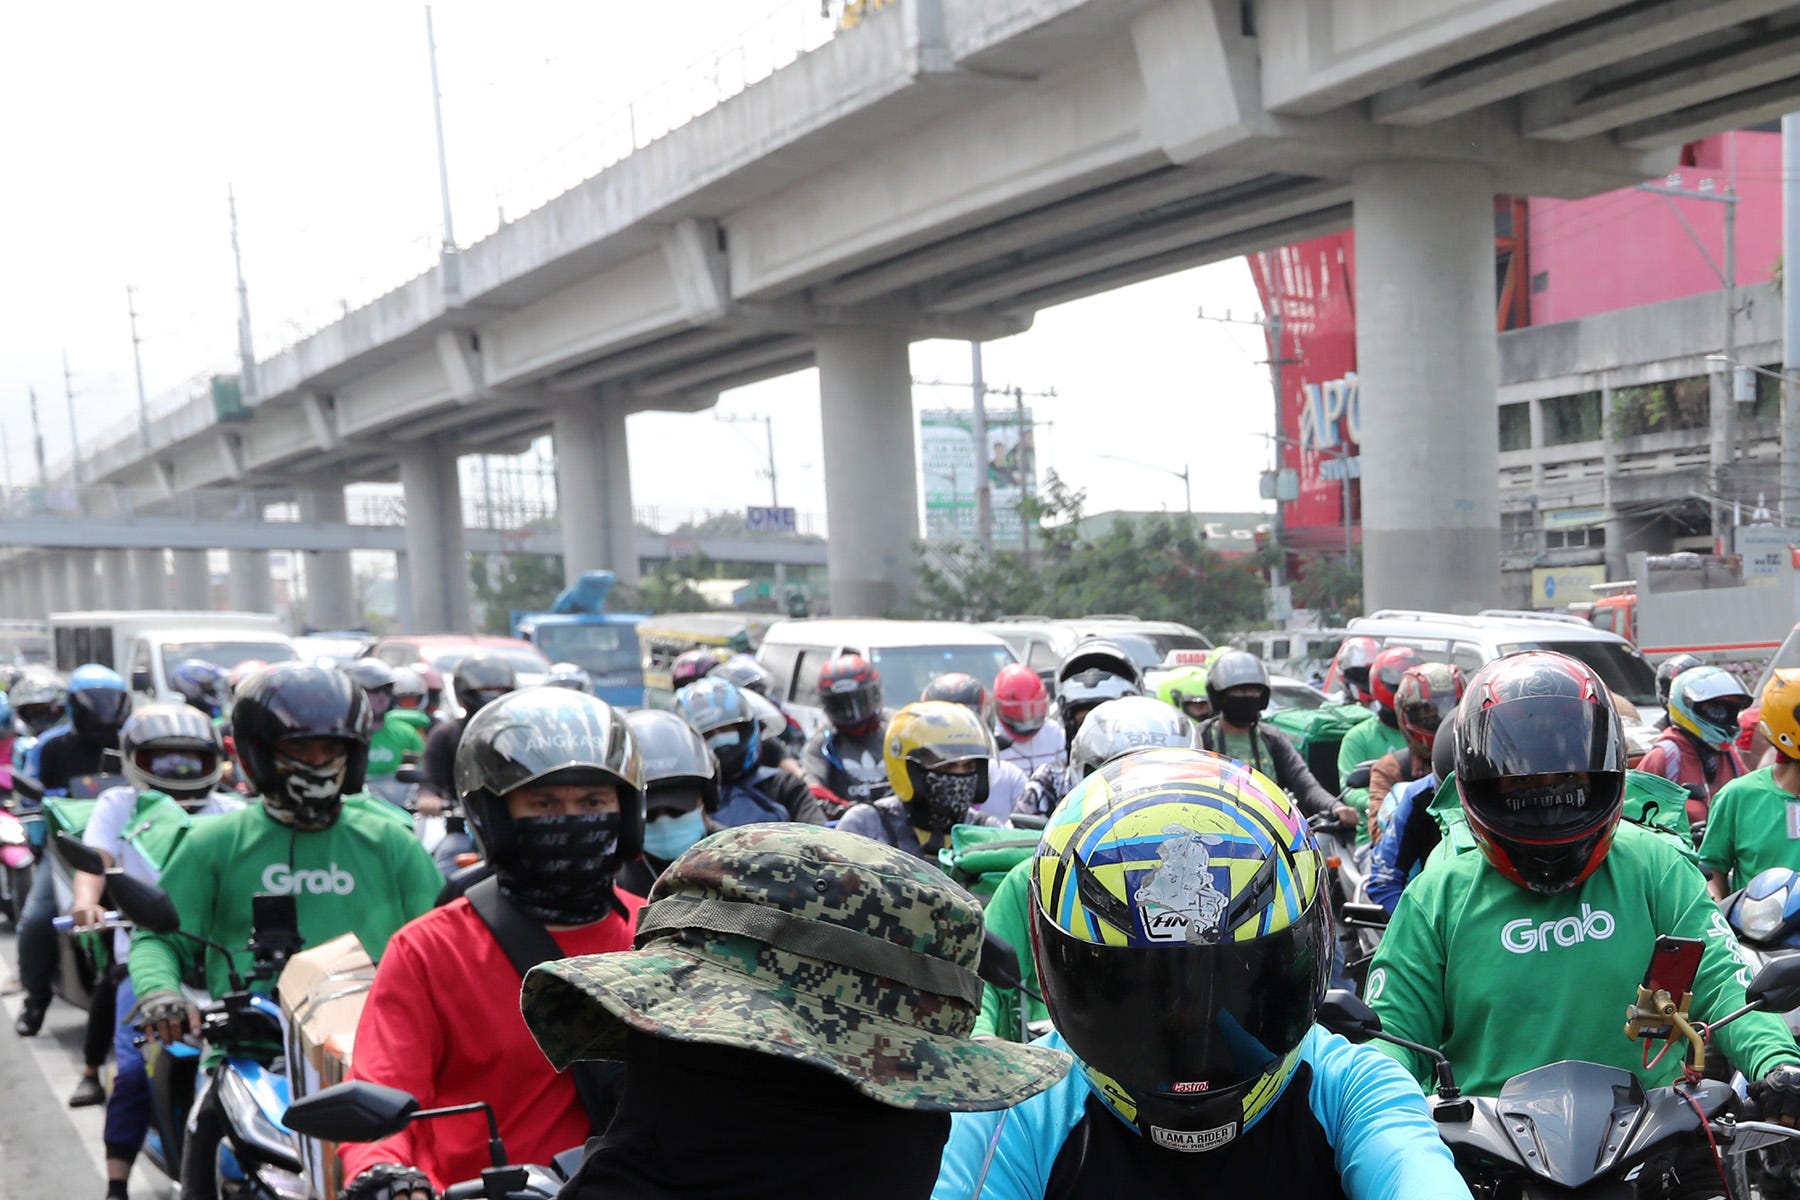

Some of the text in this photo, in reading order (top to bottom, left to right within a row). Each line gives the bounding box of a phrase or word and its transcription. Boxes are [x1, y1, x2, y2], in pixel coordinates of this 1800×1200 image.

[262, 862, 355, 895] Grab
[1501, 903, 1616, 954] Grab
[1172, 1082, 1209, 1092] Castrol
[1166, 1134, 1183, 1143] AM
[1187, 1135, 1194, 1143] A
[1197, 1128, 1228, 1143] RIDER
